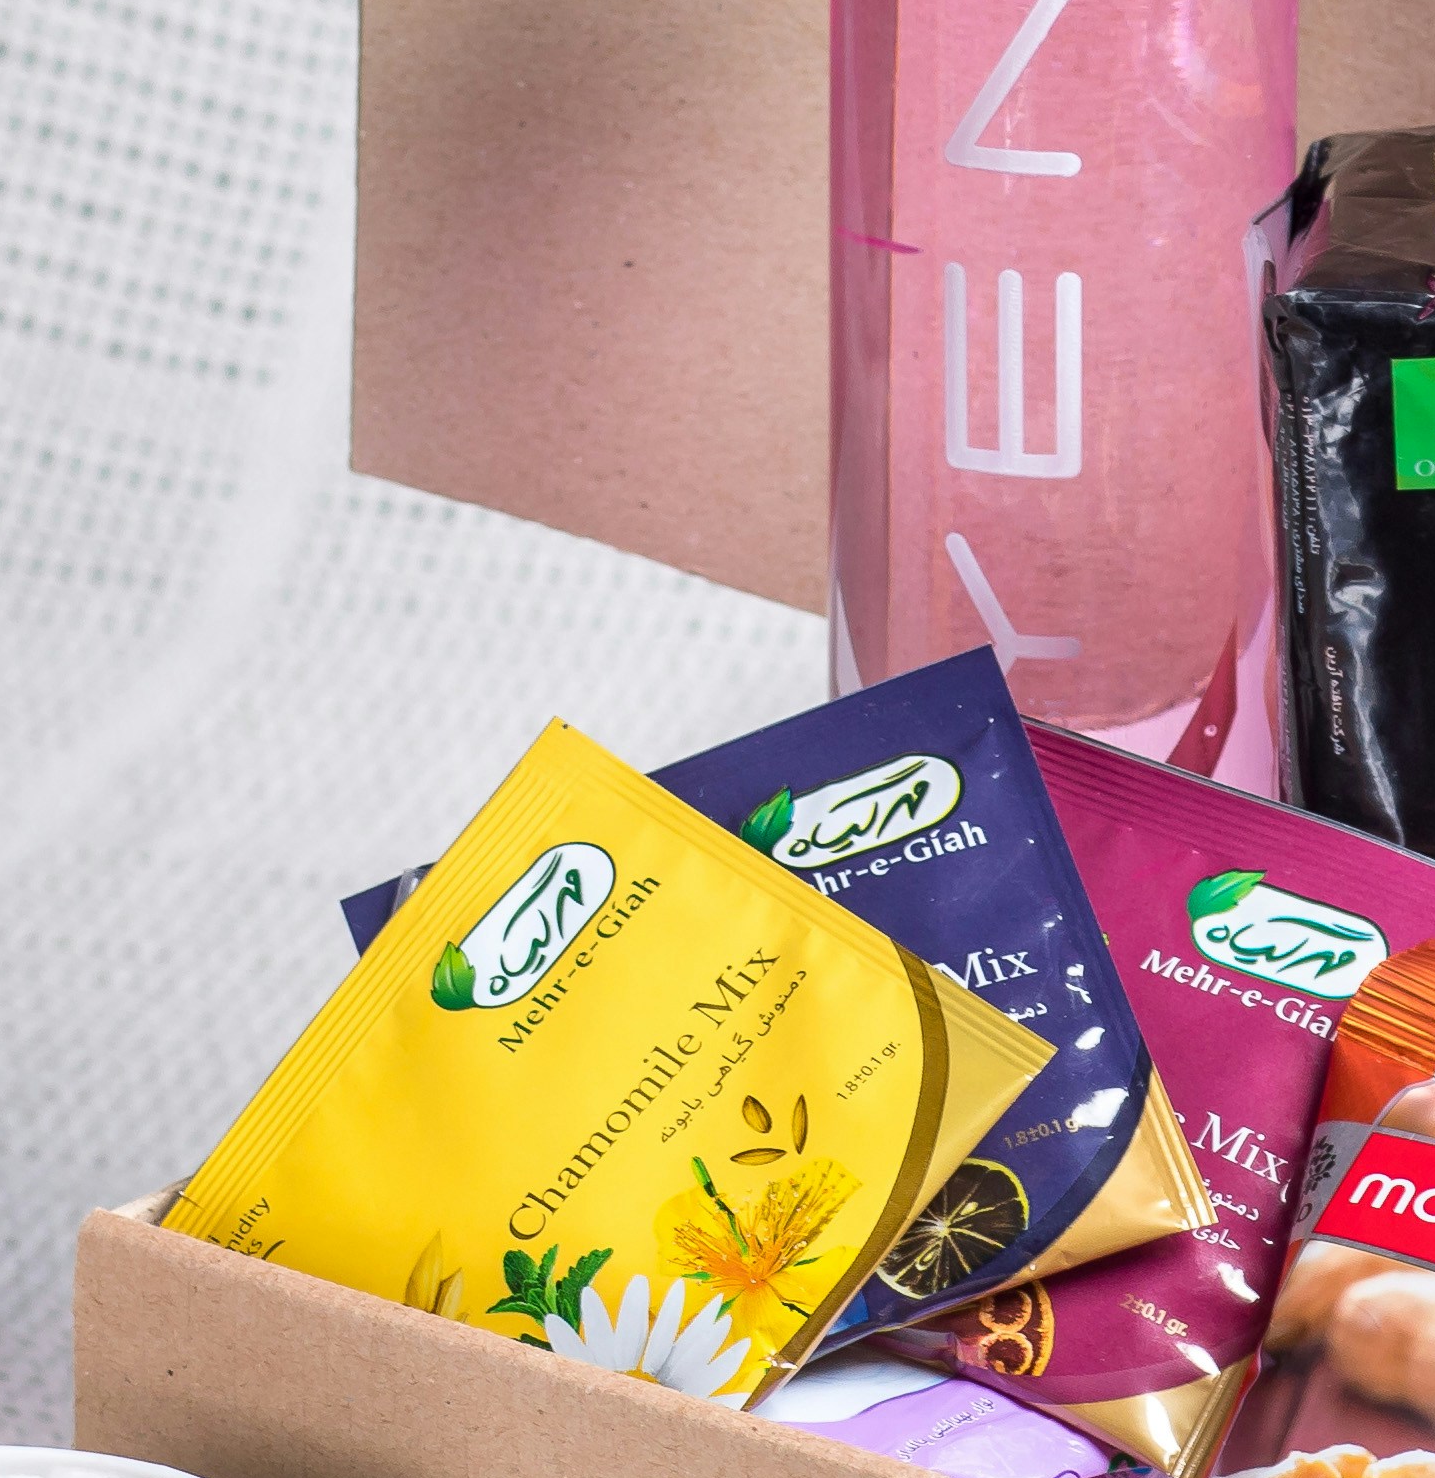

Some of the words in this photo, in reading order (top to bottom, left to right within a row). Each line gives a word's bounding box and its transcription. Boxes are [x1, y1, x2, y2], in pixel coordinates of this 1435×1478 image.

[756, 968, 808, 1038] دمنوش
[508, 1031, 703, 1242] Chamomile
[688, 947, 782, 1031] Mix
[707, 1031, 754, 1098] گیاهی
[835, 1056, 884, 1102] 1.8±0.1
[882, 1040, 903, 1060] gr.
[659, 1097, 704, 1144] بابونه
[1190, 1110, 1289, 1185] Mix
[1165, 1317, 1189, 1337] gr.
